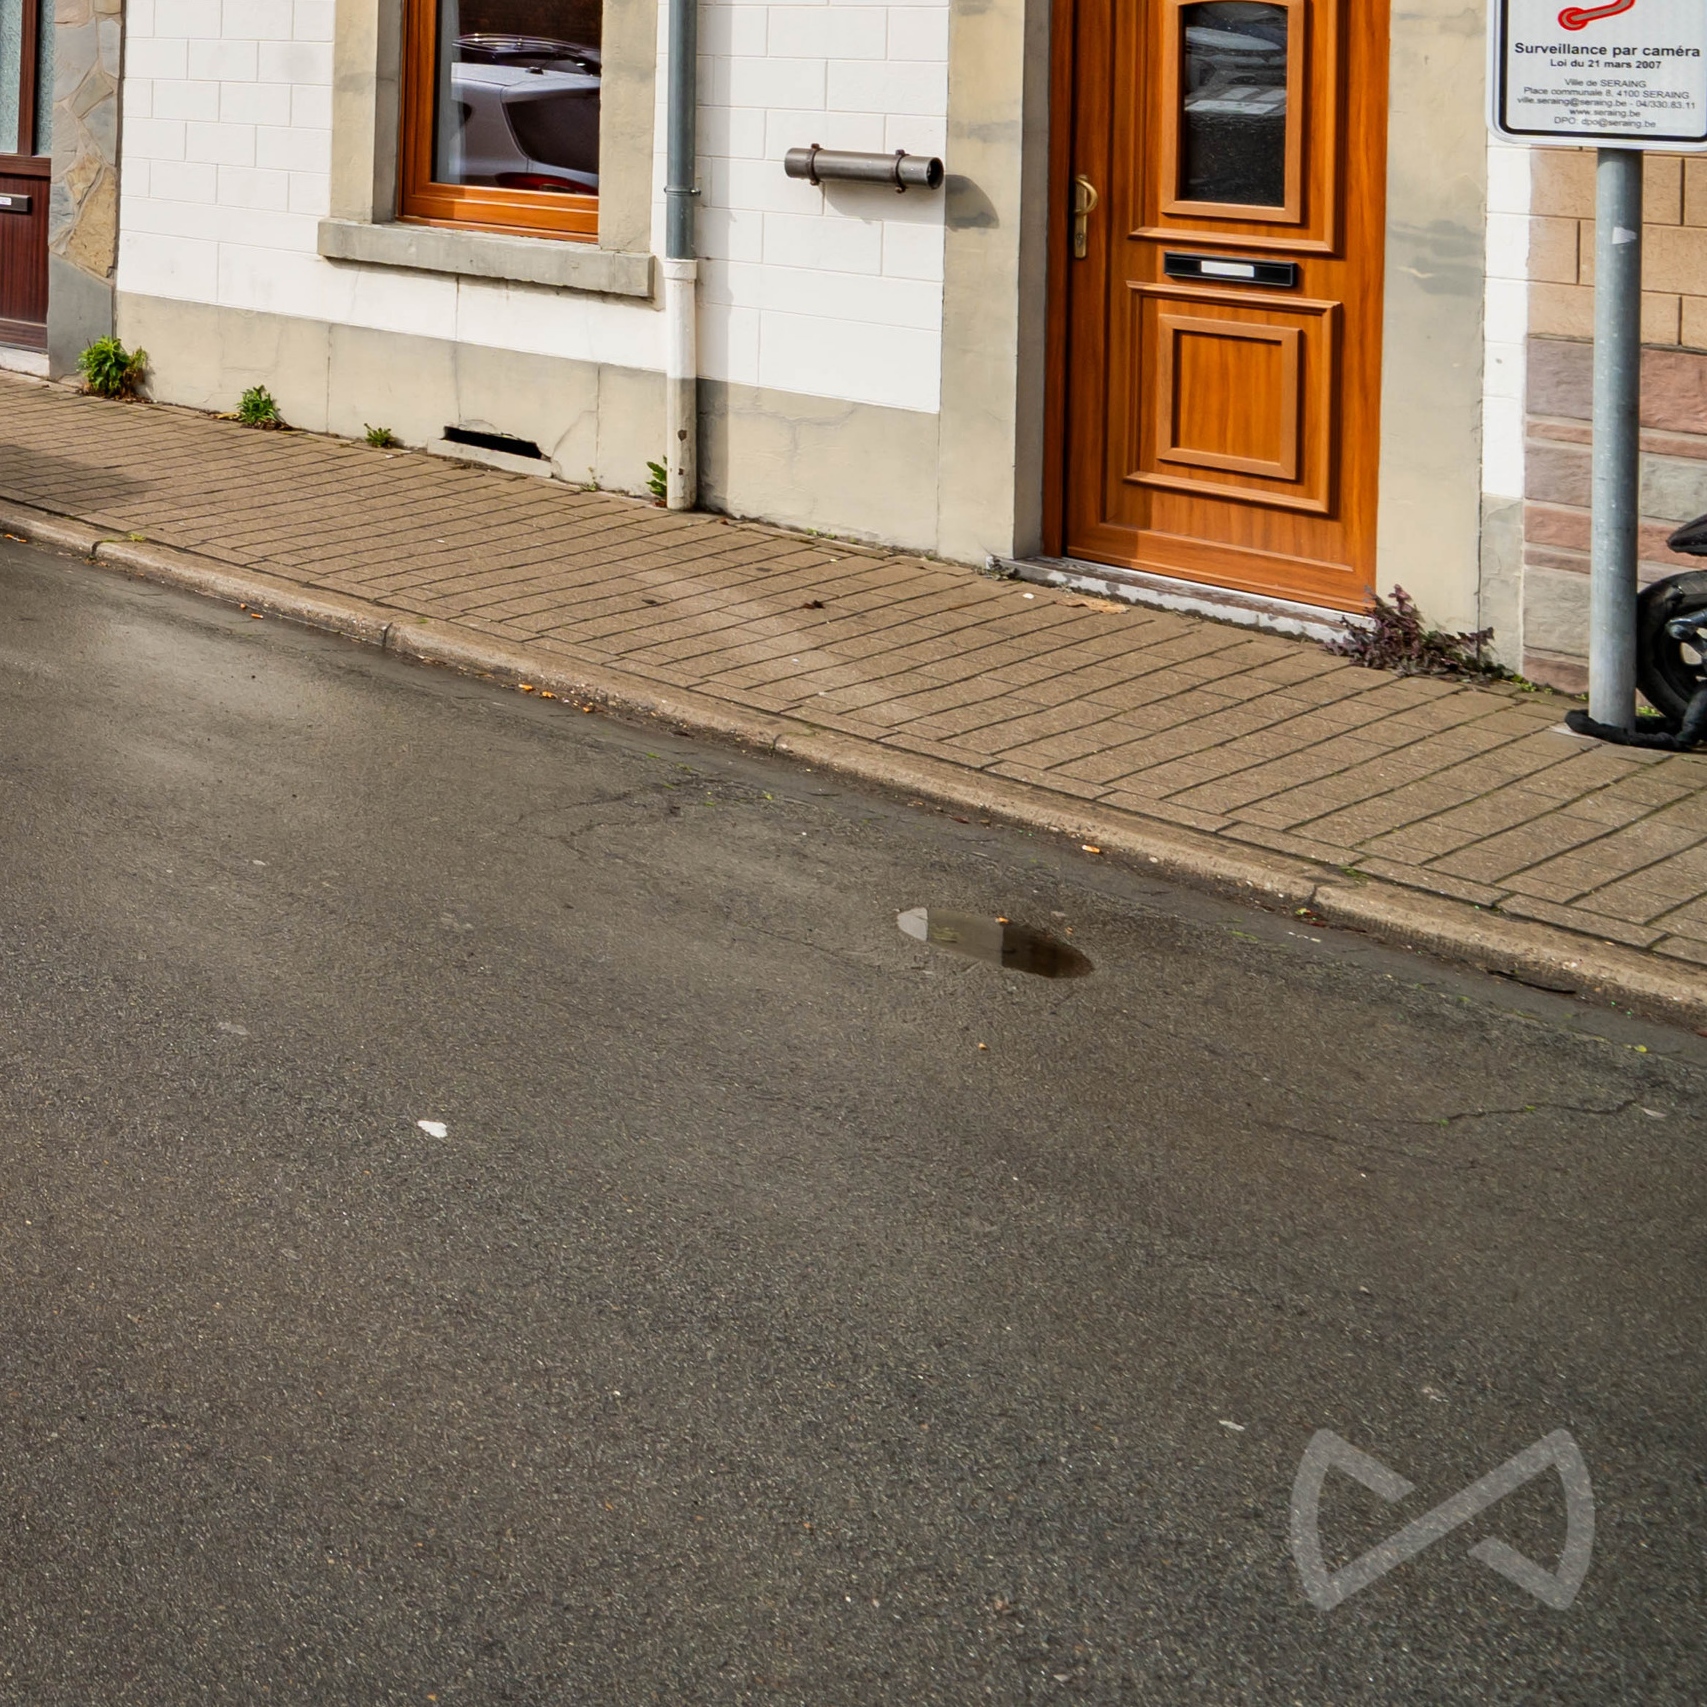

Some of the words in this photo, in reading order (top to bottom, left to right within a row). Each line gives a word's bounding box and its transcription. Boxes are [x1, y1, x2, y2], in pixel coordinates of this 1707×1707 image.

[1515, 43, 1607, 55] Surveillance
[1613, 46, 1638, 58] par
[1642, 45, 1701, 57] caméra
[1550, 59, 1567, 67] Loi
[1571, 60, 1584, 68] du
[1588, 60, 1600, 68] 21
[1604, 61, 1632, 69] mars
[1636, 60, 1662, 69] 2007
[1564, 78, 1584, 86] Ville
[1600, 79, 1647, 88] SERAING
[1523, 86, 1548, 95] Place
[1551, 88, 1603, 96] communale
[1616, 90, 1640, 98] 4100
[1642, 90, 1690, 99] SERAING
[1517, 96, 1627, 108] ville.seraing@seraing.be
[1569, 109, 1641, 118] www.seraing.be
[1581, 118, 1657, 129] dpo@seraing.be
